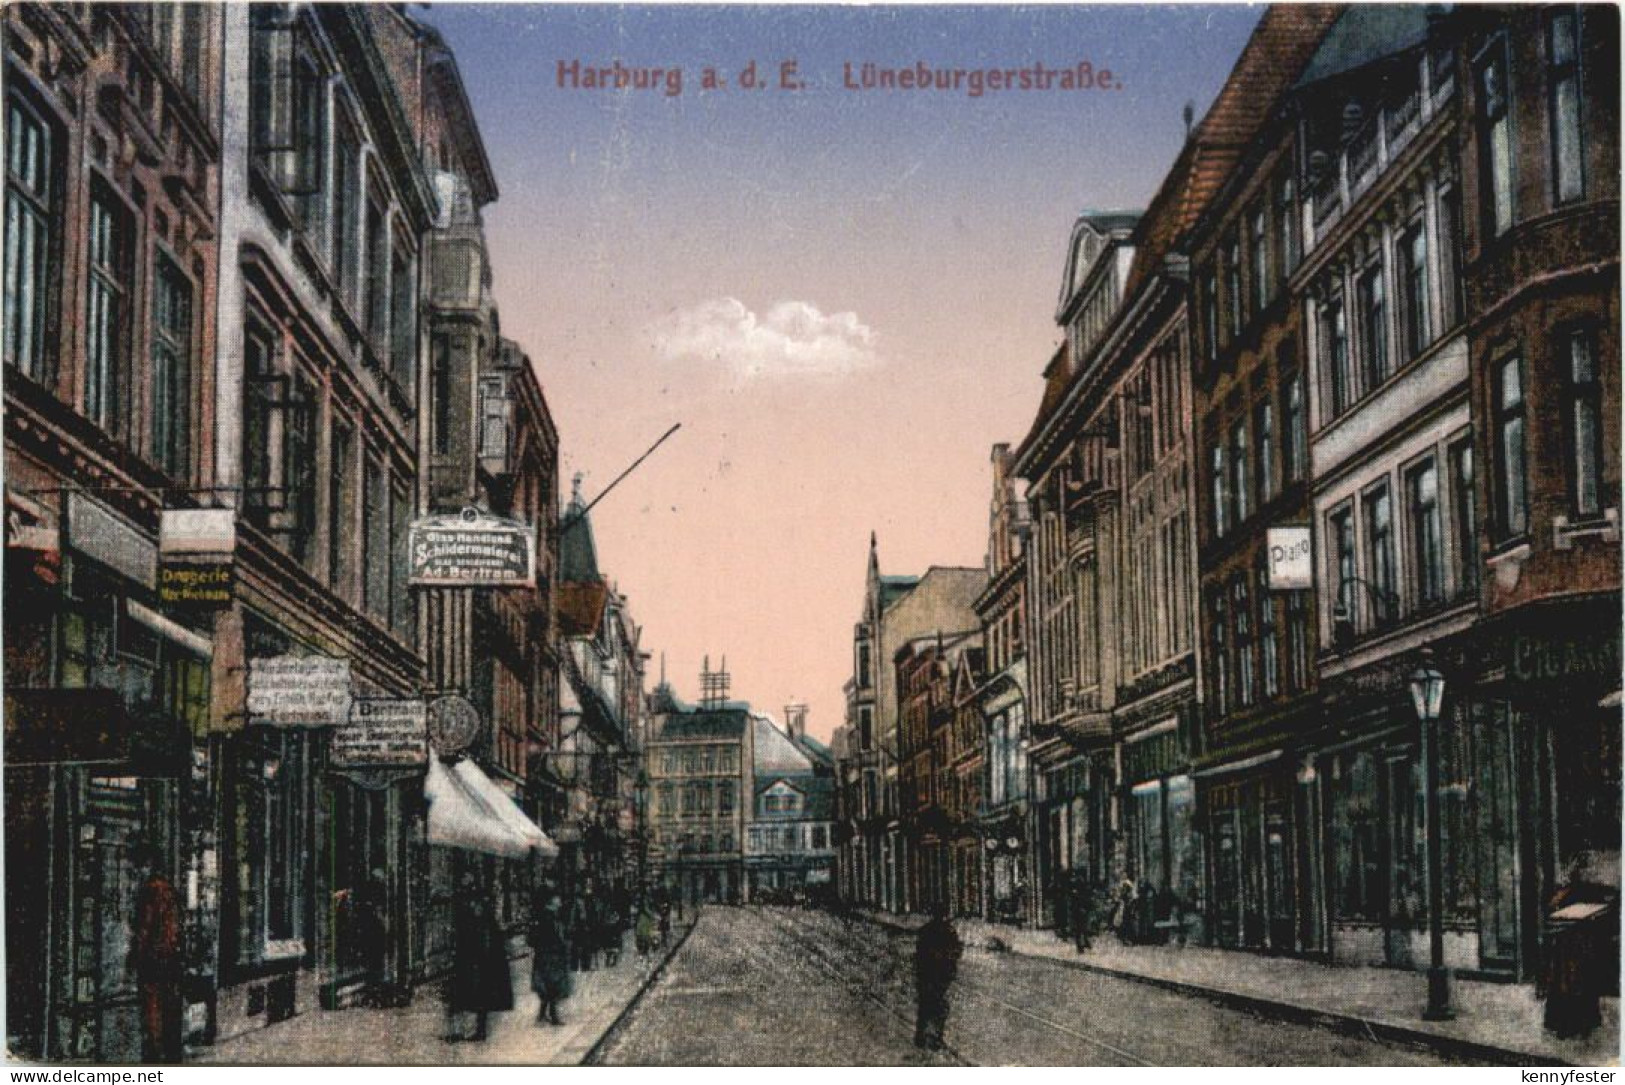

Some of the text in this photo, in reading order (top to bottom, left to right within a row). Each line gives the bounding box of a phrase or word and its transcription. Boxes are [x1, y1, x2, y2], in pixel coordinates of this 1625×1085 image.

[1270, 538, 1309, 575] Piano
[162, 566, 230, 586] Drogerie
[449, 565, 517, 578] Bertram
